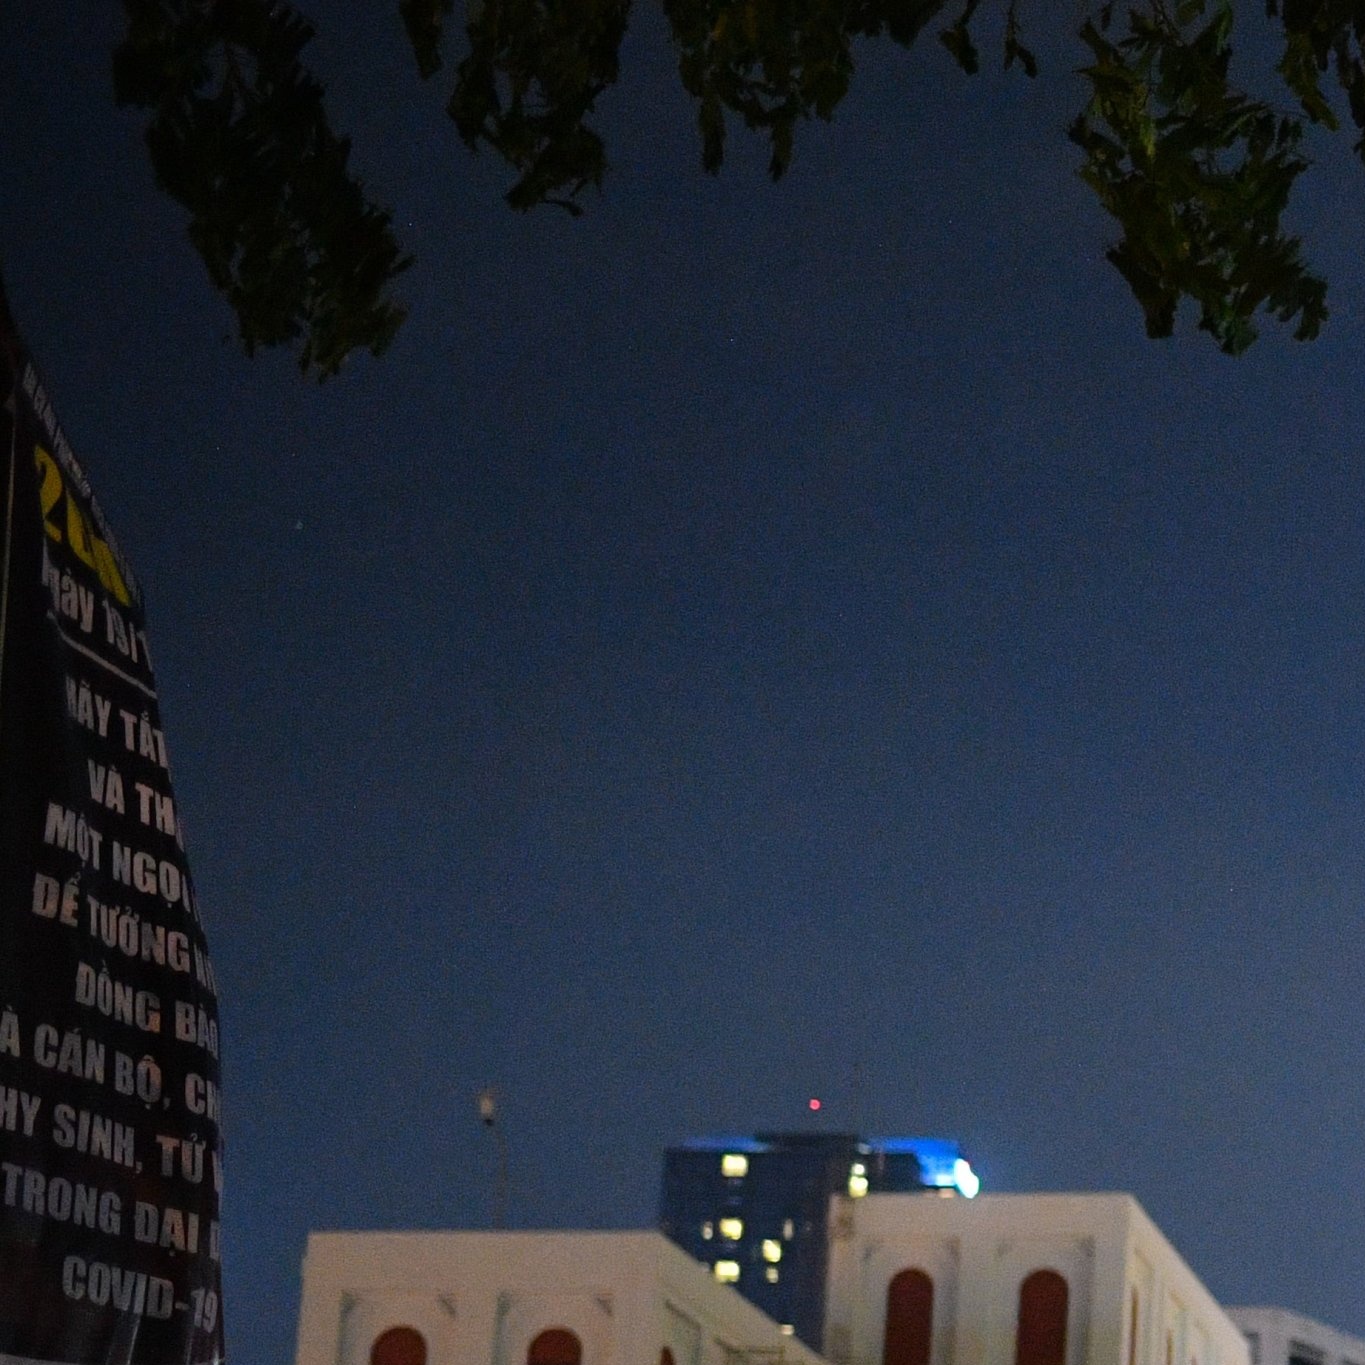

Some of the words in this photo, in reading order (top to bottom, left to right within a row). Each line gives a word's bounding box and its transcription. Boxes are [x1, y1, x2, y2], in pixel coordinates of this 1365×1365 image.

[44, 801, 103, 871] MỘT
[88, 757, 125, 815] VÀ
[134, 781, 185, 853] TH
[87, 894, 190, 974] TƯỞNG
[75, 959, 162, 1034] ĐỒNG
[34, 1022, 105, 1085] CÁN
[114, 1049, 171, 1111] BỘ,
[52, 1103, 143, 1175] SINH,
[155, 1131, 207, 1184] TỬ
[2, 1161, 122, 1236] TRONG
[134, 1200, 200, 1257] ĐẠI
[62, 1254, 218, 1334] COVID-19
